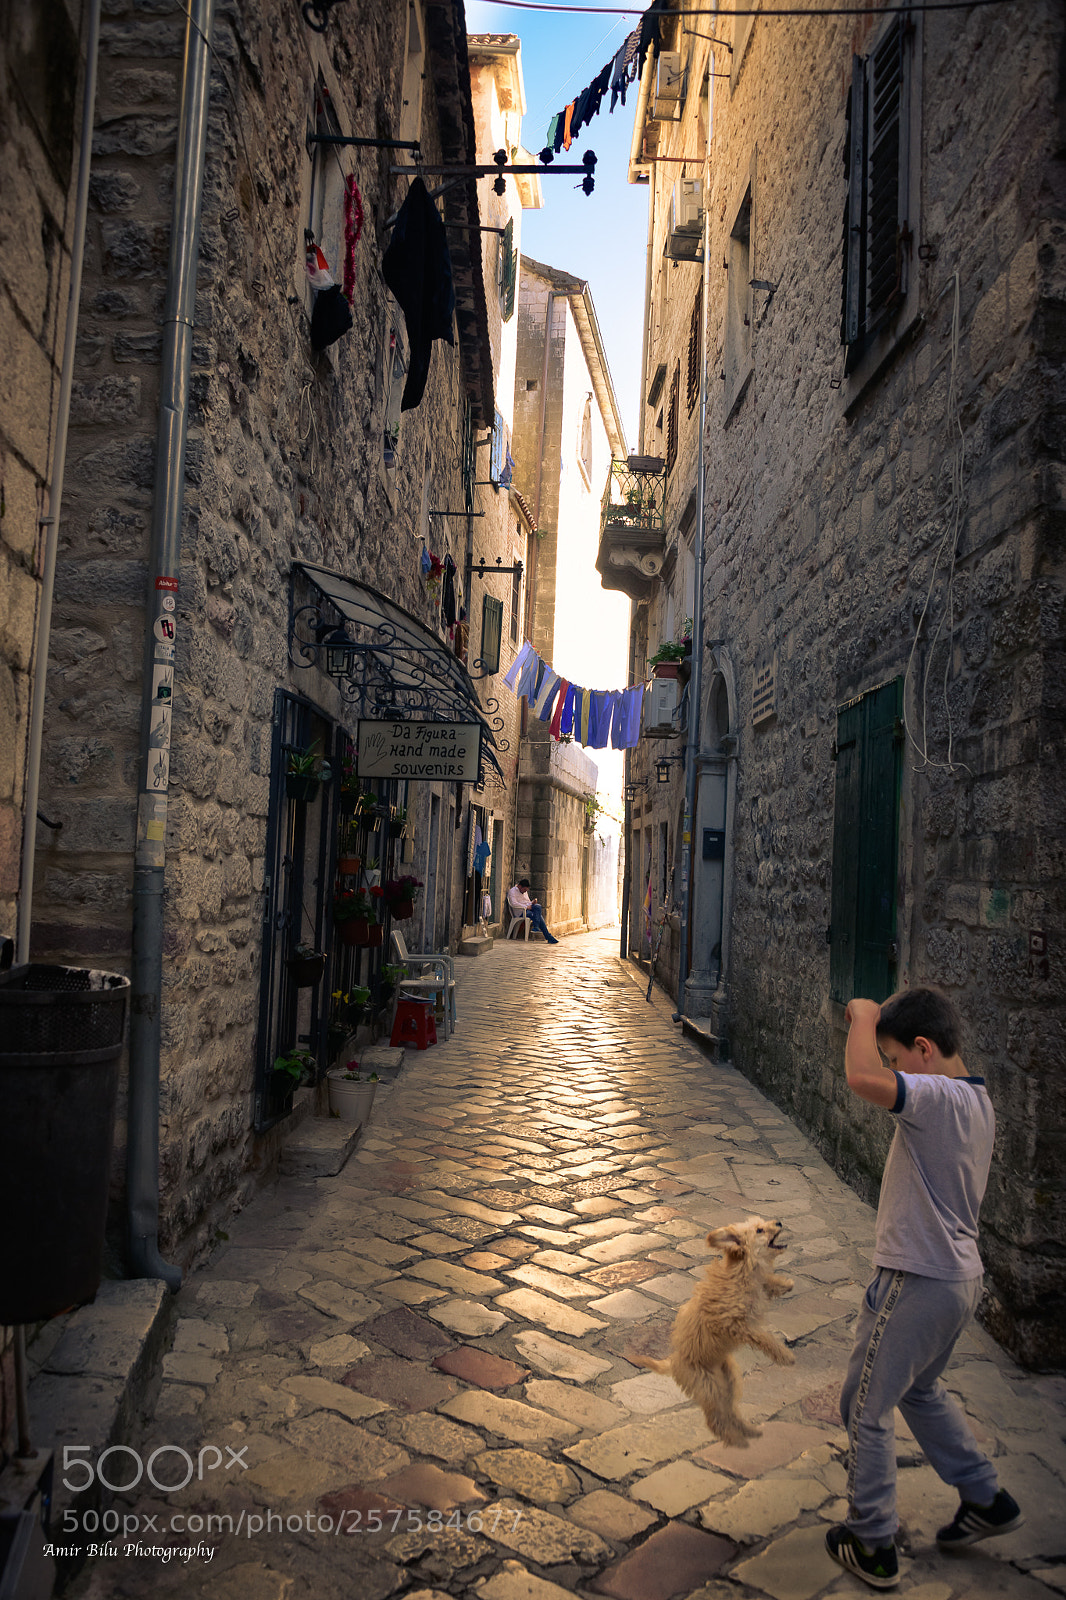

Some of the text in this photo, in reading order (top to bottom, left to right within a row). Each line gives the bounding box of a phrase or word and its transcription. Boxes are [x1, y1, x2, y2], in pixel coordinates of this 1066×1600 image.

[392, 724, 411, 739] Da
[389, 743, 466, 759] Hand made
